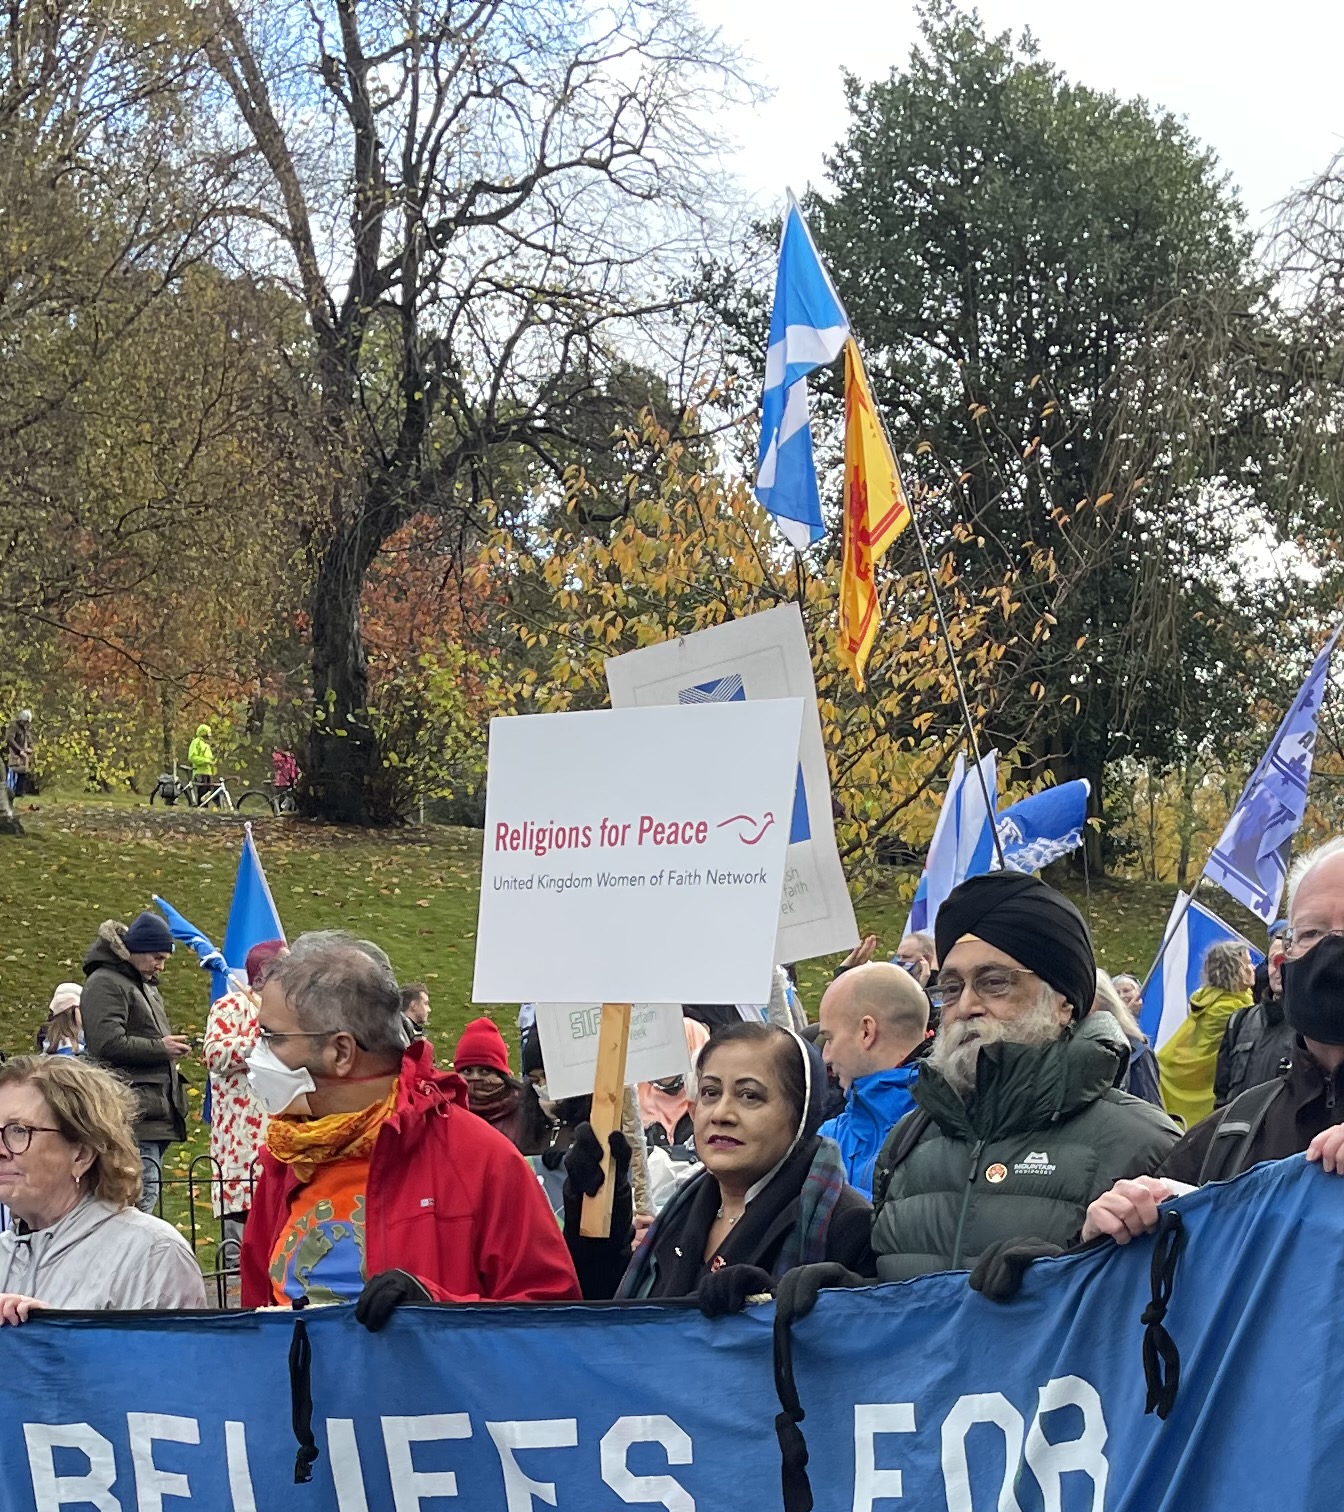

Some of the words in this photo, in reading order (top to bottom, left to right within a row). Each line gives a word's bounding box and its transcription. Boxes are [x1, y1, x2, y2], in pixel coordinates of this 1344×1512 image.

[495, 820, 592, 856] Religions
[600, 818, 631, 848] for
[638, 814, 708, 846] Peace
[493, 874, 534, 891] United
[537, 873, 593, 894] Kingdom
[597, 871, 645, 887] Women
[650, 870, 665, 887] of
[667, 869, 702, 887] Faith
[705, 867, 768, 886] Network
